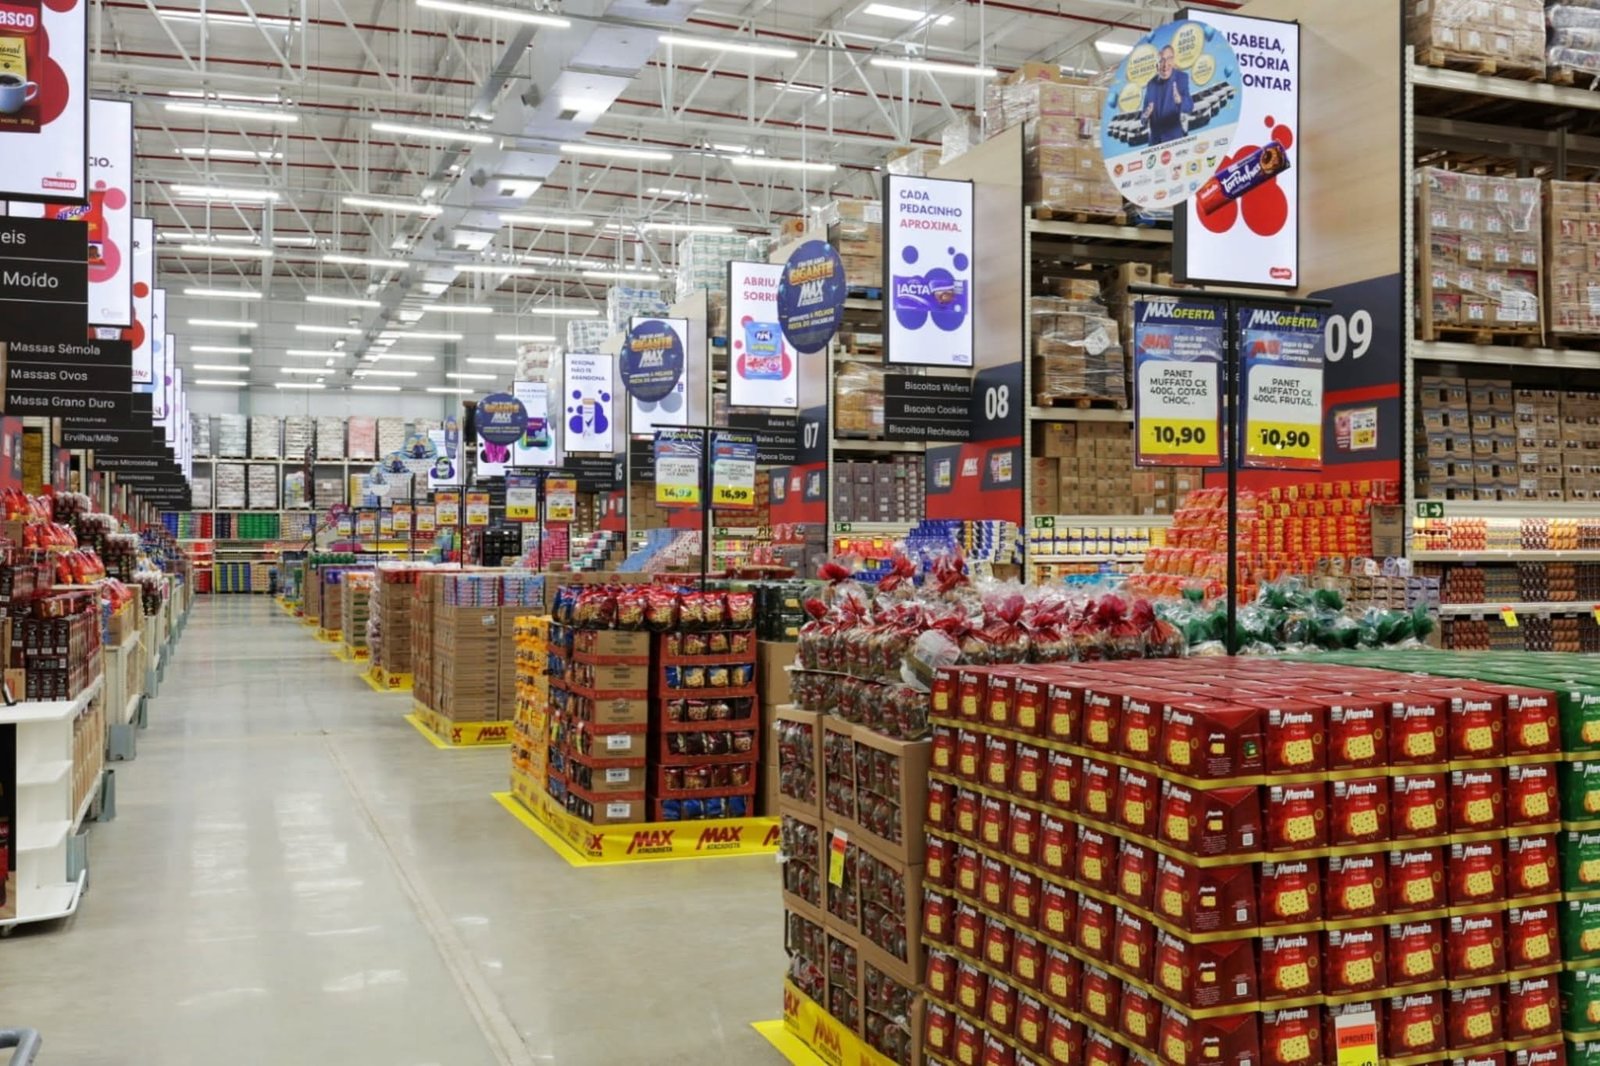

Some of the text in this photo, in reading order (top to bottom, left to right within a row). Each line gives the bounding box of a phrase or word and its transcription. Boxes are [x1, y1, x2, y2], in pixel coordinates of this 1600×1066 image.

[1227, 32, 1286, 54] ISABELA,
[1242, 73, 1291, 92] ONTAR
[899, 189, 930, 201] CADA
[899, 203, 962, 217] PEDACINHO
[899, 218, 962, 232] APROXIMA.
[3, 271, 59, 288] Moído
[789, 259, 834, 286] GIGANTE
[797, 279, 825, 307] MAX
[897, 283, 931, 297] LACTA
[1325, 310, 1373, 362] 09
[10, 341, 101, 355] Massas Sêmola
[638, 349, 665, 368] MAX
[10, 369, 88, 381] Massas Ovos
[1163, 369, 1193, 378] PANET
[905, 381, 969, 392] Biscoitos Wafers
[1150, 378, 1207, 387] MUFFATO CX
[1272, 378, 1301, 388] PANET
[1177, 387, 1208, 396] GOTAS
[1258, 386, 1312, 397] MUFFATO CX
[10, 395, 115, 409] Massa Grano Duro
[985, 384, 1009, 420] 08
[904, 404, 968, 415] Biscoito Cookies
[768, 419, 785, 427] Balas
[804, 422, 819, 449] 07
[889, 424, 969, 437] Biscoitos Recheados
[1154, 426, 1206, 447] 10,90
[64, 433, 119, 443] Ervilha/Milho
[1260, 428, 1310, 449] 10,90
[756, 452, 778, 461] Pipoca
[779, 453, 795, 461] Doce
[720, 489, 747, 499] 16,99
[477, 727, 508, 741] MAX
[626, 829, 676, 855] MAX
[696, 826, 743, 850] MAX
